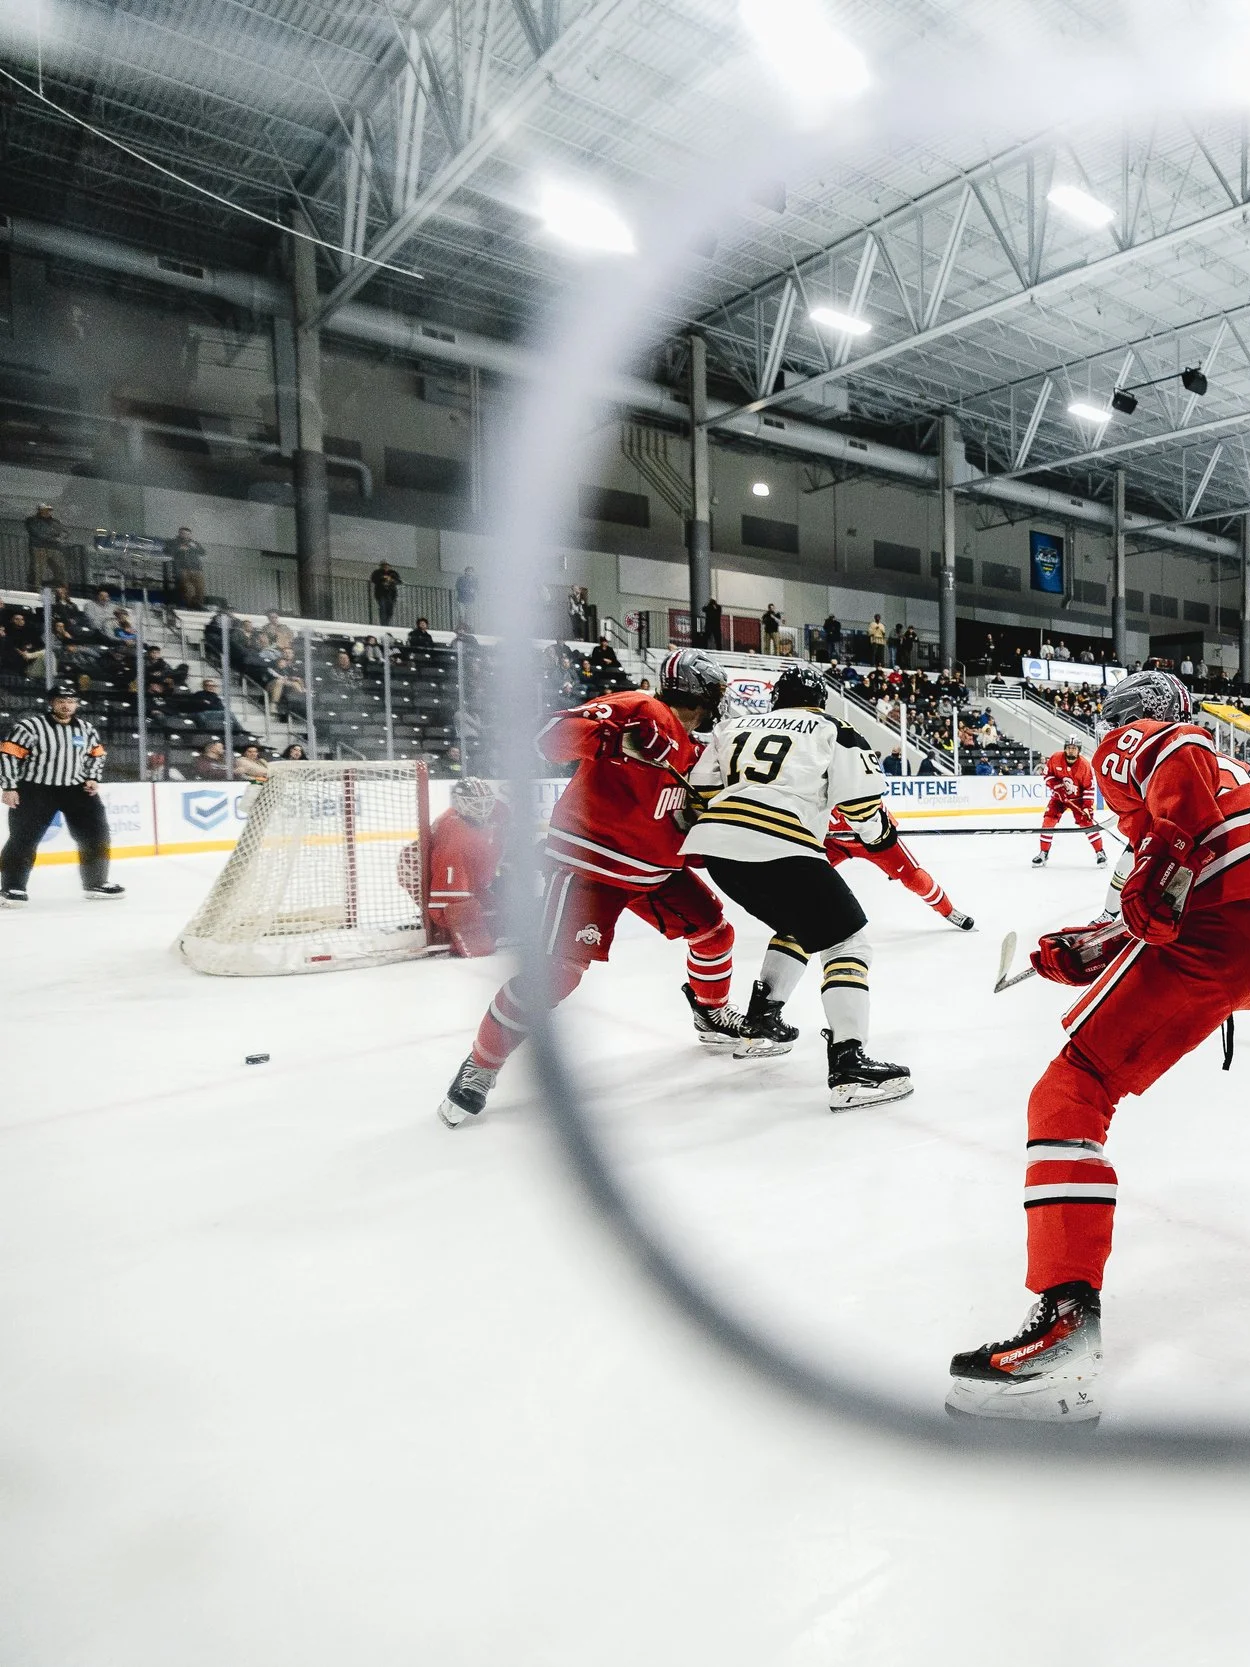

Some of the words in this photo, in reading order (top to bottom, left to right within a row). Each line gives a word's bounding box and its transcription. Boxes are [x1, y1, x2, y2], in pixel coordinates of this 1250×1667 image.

[735, 719, 819, 734] LUNDMAN
[727, 731, 793, 786] 19
[1101, 728, 1143, 784] 29
[1011, 784, 1042, 798] PNC
[917, 796, 969, 806] Corporation
[1174, 839, 1186, 850] 29
[1000, 1340, 1044, 1366] BAUER
